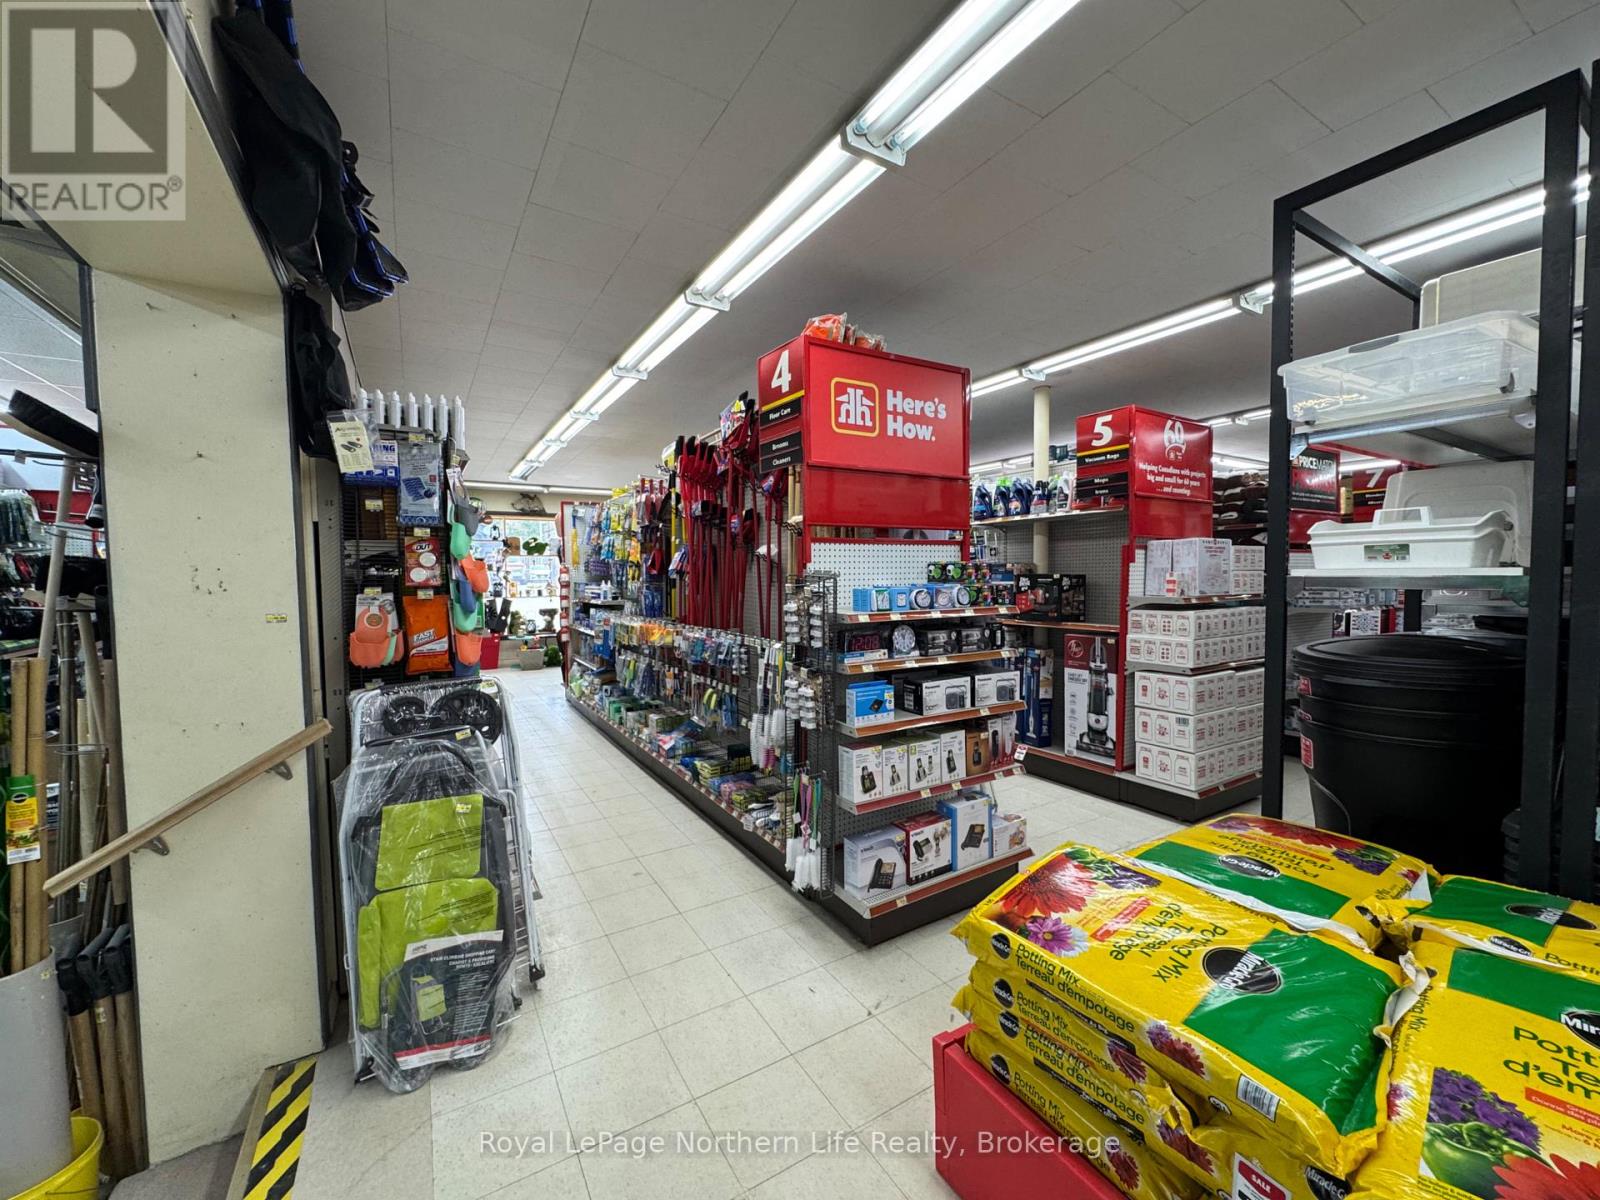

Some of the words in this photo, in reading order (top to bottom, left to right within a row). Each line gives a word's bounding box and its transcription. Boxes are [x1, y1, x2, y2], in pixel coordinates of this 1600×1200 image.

[771, 349, 791, 393] 4
[886, 389, 947, 419] Here's
[886, 414, 936, 441] How.
[1091, 415, 1113, 446] 5
[1163, 419, 1185, 447] 60
[1138, 462, 1158, 473] Helping
[1158, 464, 1180, 475] Canadians
[1365, 468, 1385, 488] 7
[1016, 944, 1056, 976] Potting
[1058, 967, 1080, 988] Mix
[1151, 955, 1190, 984] Mix
[1014, 953, 1055, 986] Terreau
[1057, 981, 1136, 1033] d'empotage
[1016, 991, 1050, 1020] Potting
[1051, 1011, 1068, 1030] Mix
[1024, 1024, 1065, 1059] Potting
[1023, 1035, 1065, 1071] Terreau
[1066, 1066, 1145, 1125] d'empotage
[1014, 1072, 1046, 1107] Potting
[1048, 1100, 1066, 1121] Mix
[1251, 1174, 1272, 1193] SALE
[1306, 1166, 1347, 1200] Miracle-G
